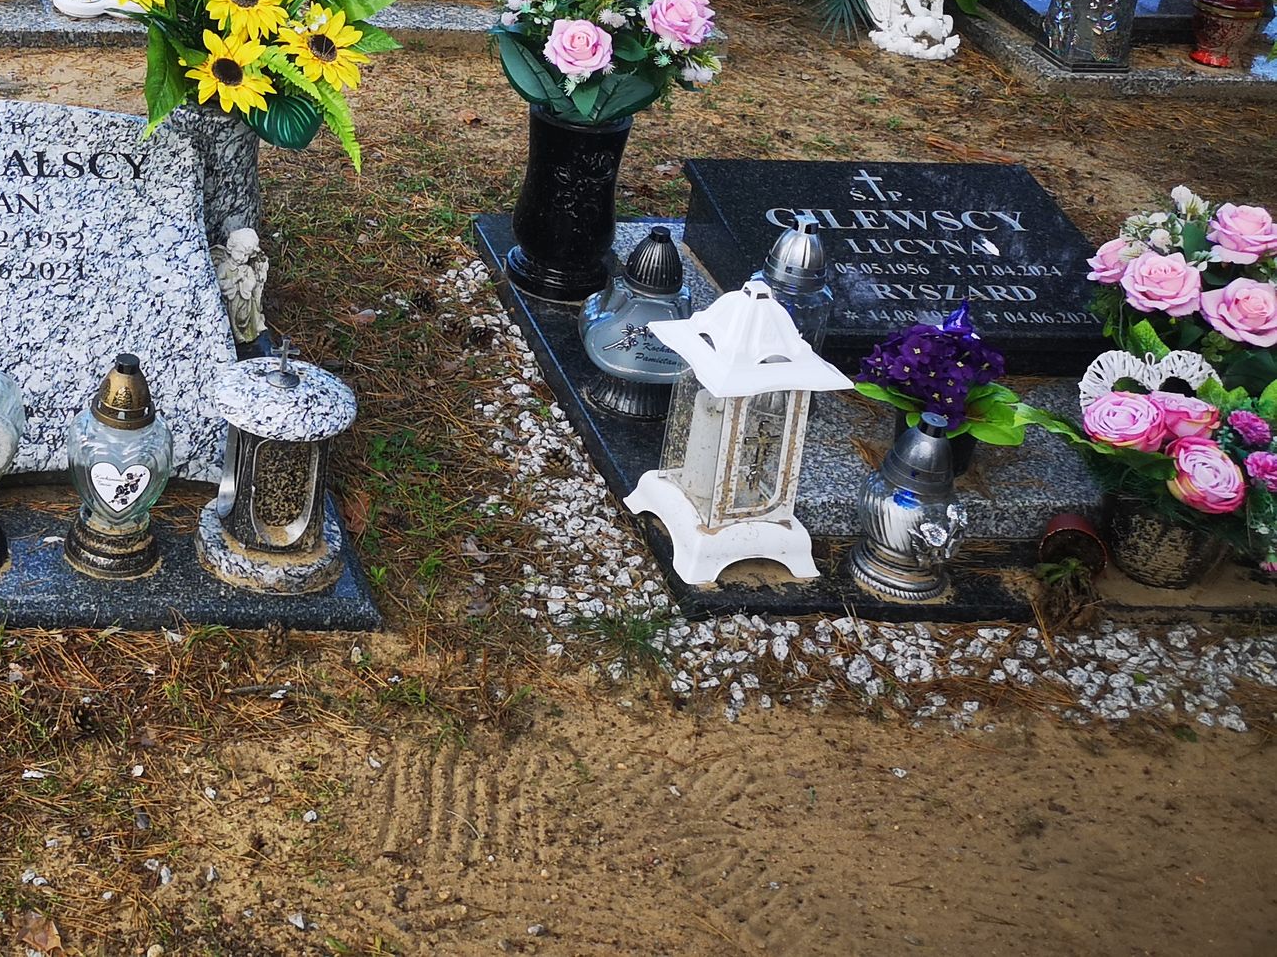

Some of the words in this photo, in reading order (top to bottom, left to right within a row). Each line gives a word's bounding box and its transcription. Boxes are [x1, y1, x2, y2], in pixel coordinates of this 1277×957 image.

[765, 207, 1030, 232] GILEWSCY
[834, 262, 931, 275] 05.05.1956
[967, 264, 1063, 277] 17.04.2024
[868, 284, 1037, 302] RYSZARD
[1003, 310, 1102, 325] 04.06.2021
